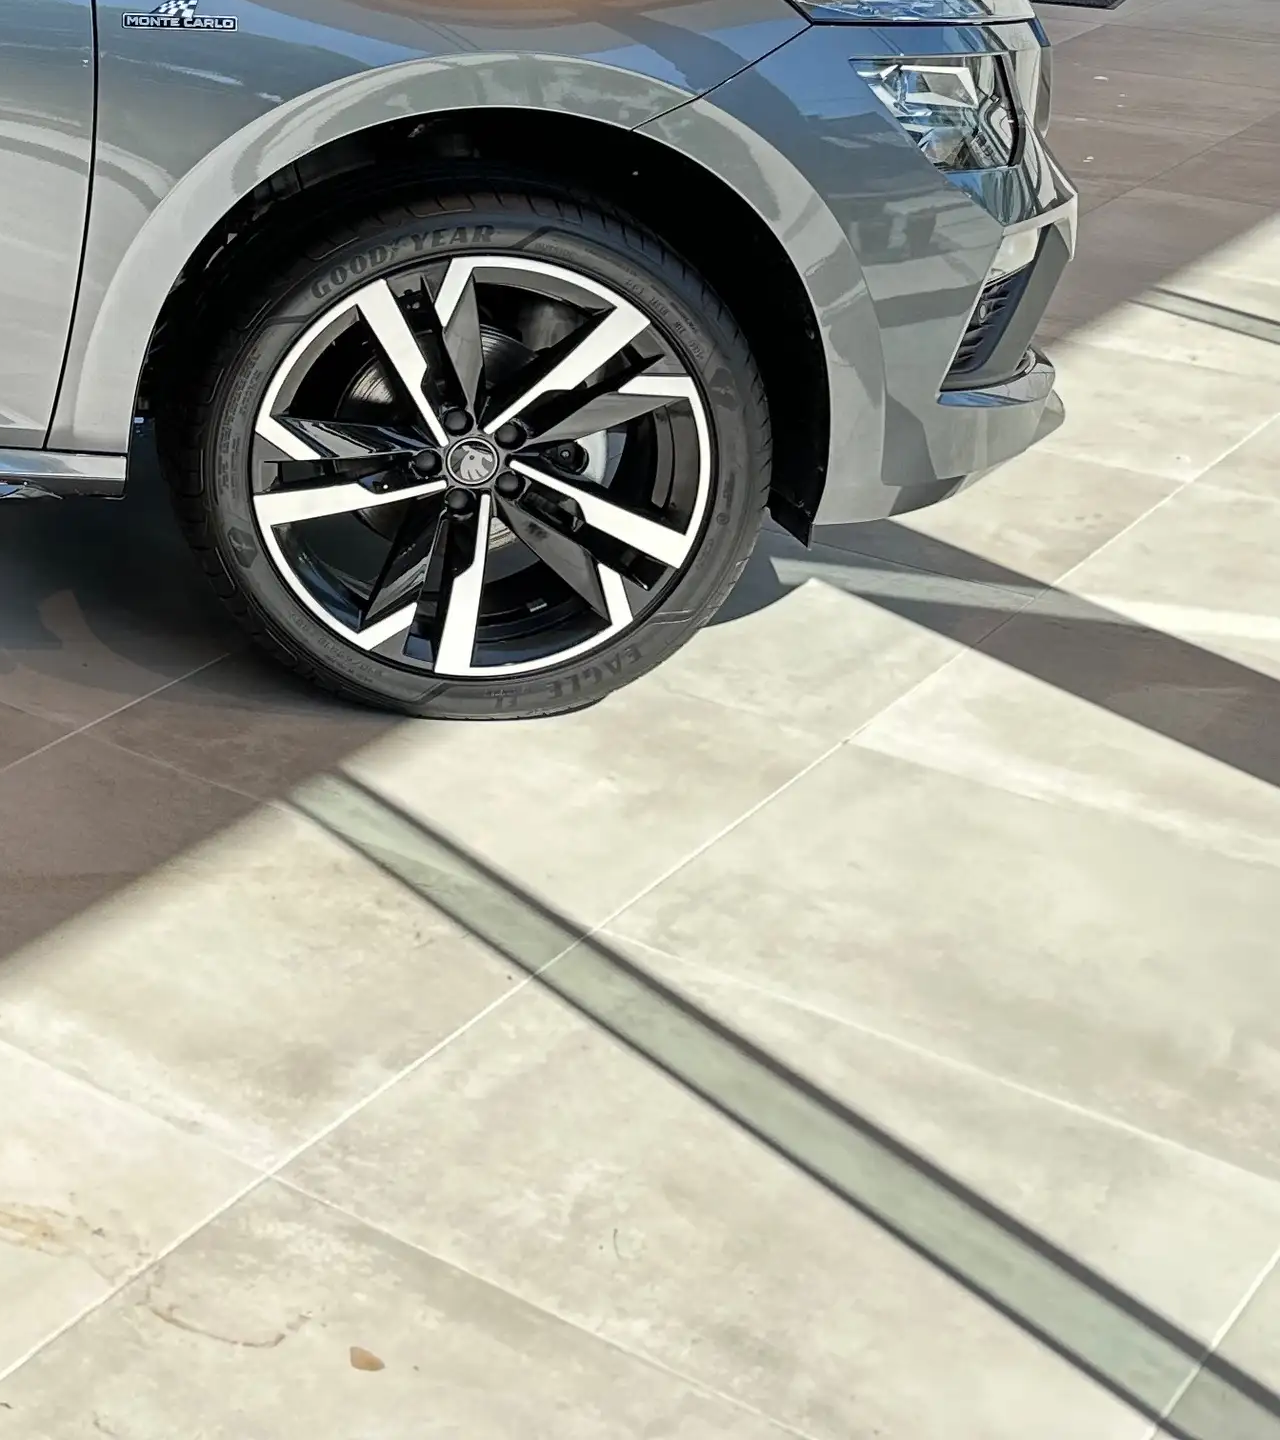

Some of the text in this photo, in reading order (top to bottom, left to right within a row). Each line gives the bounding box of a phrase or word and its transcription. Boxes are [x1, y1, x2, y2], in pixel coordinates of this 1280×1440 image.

[126, 15, 234, 28] MONTE CARLO
[546, 643, 643, 699] EAGLE
